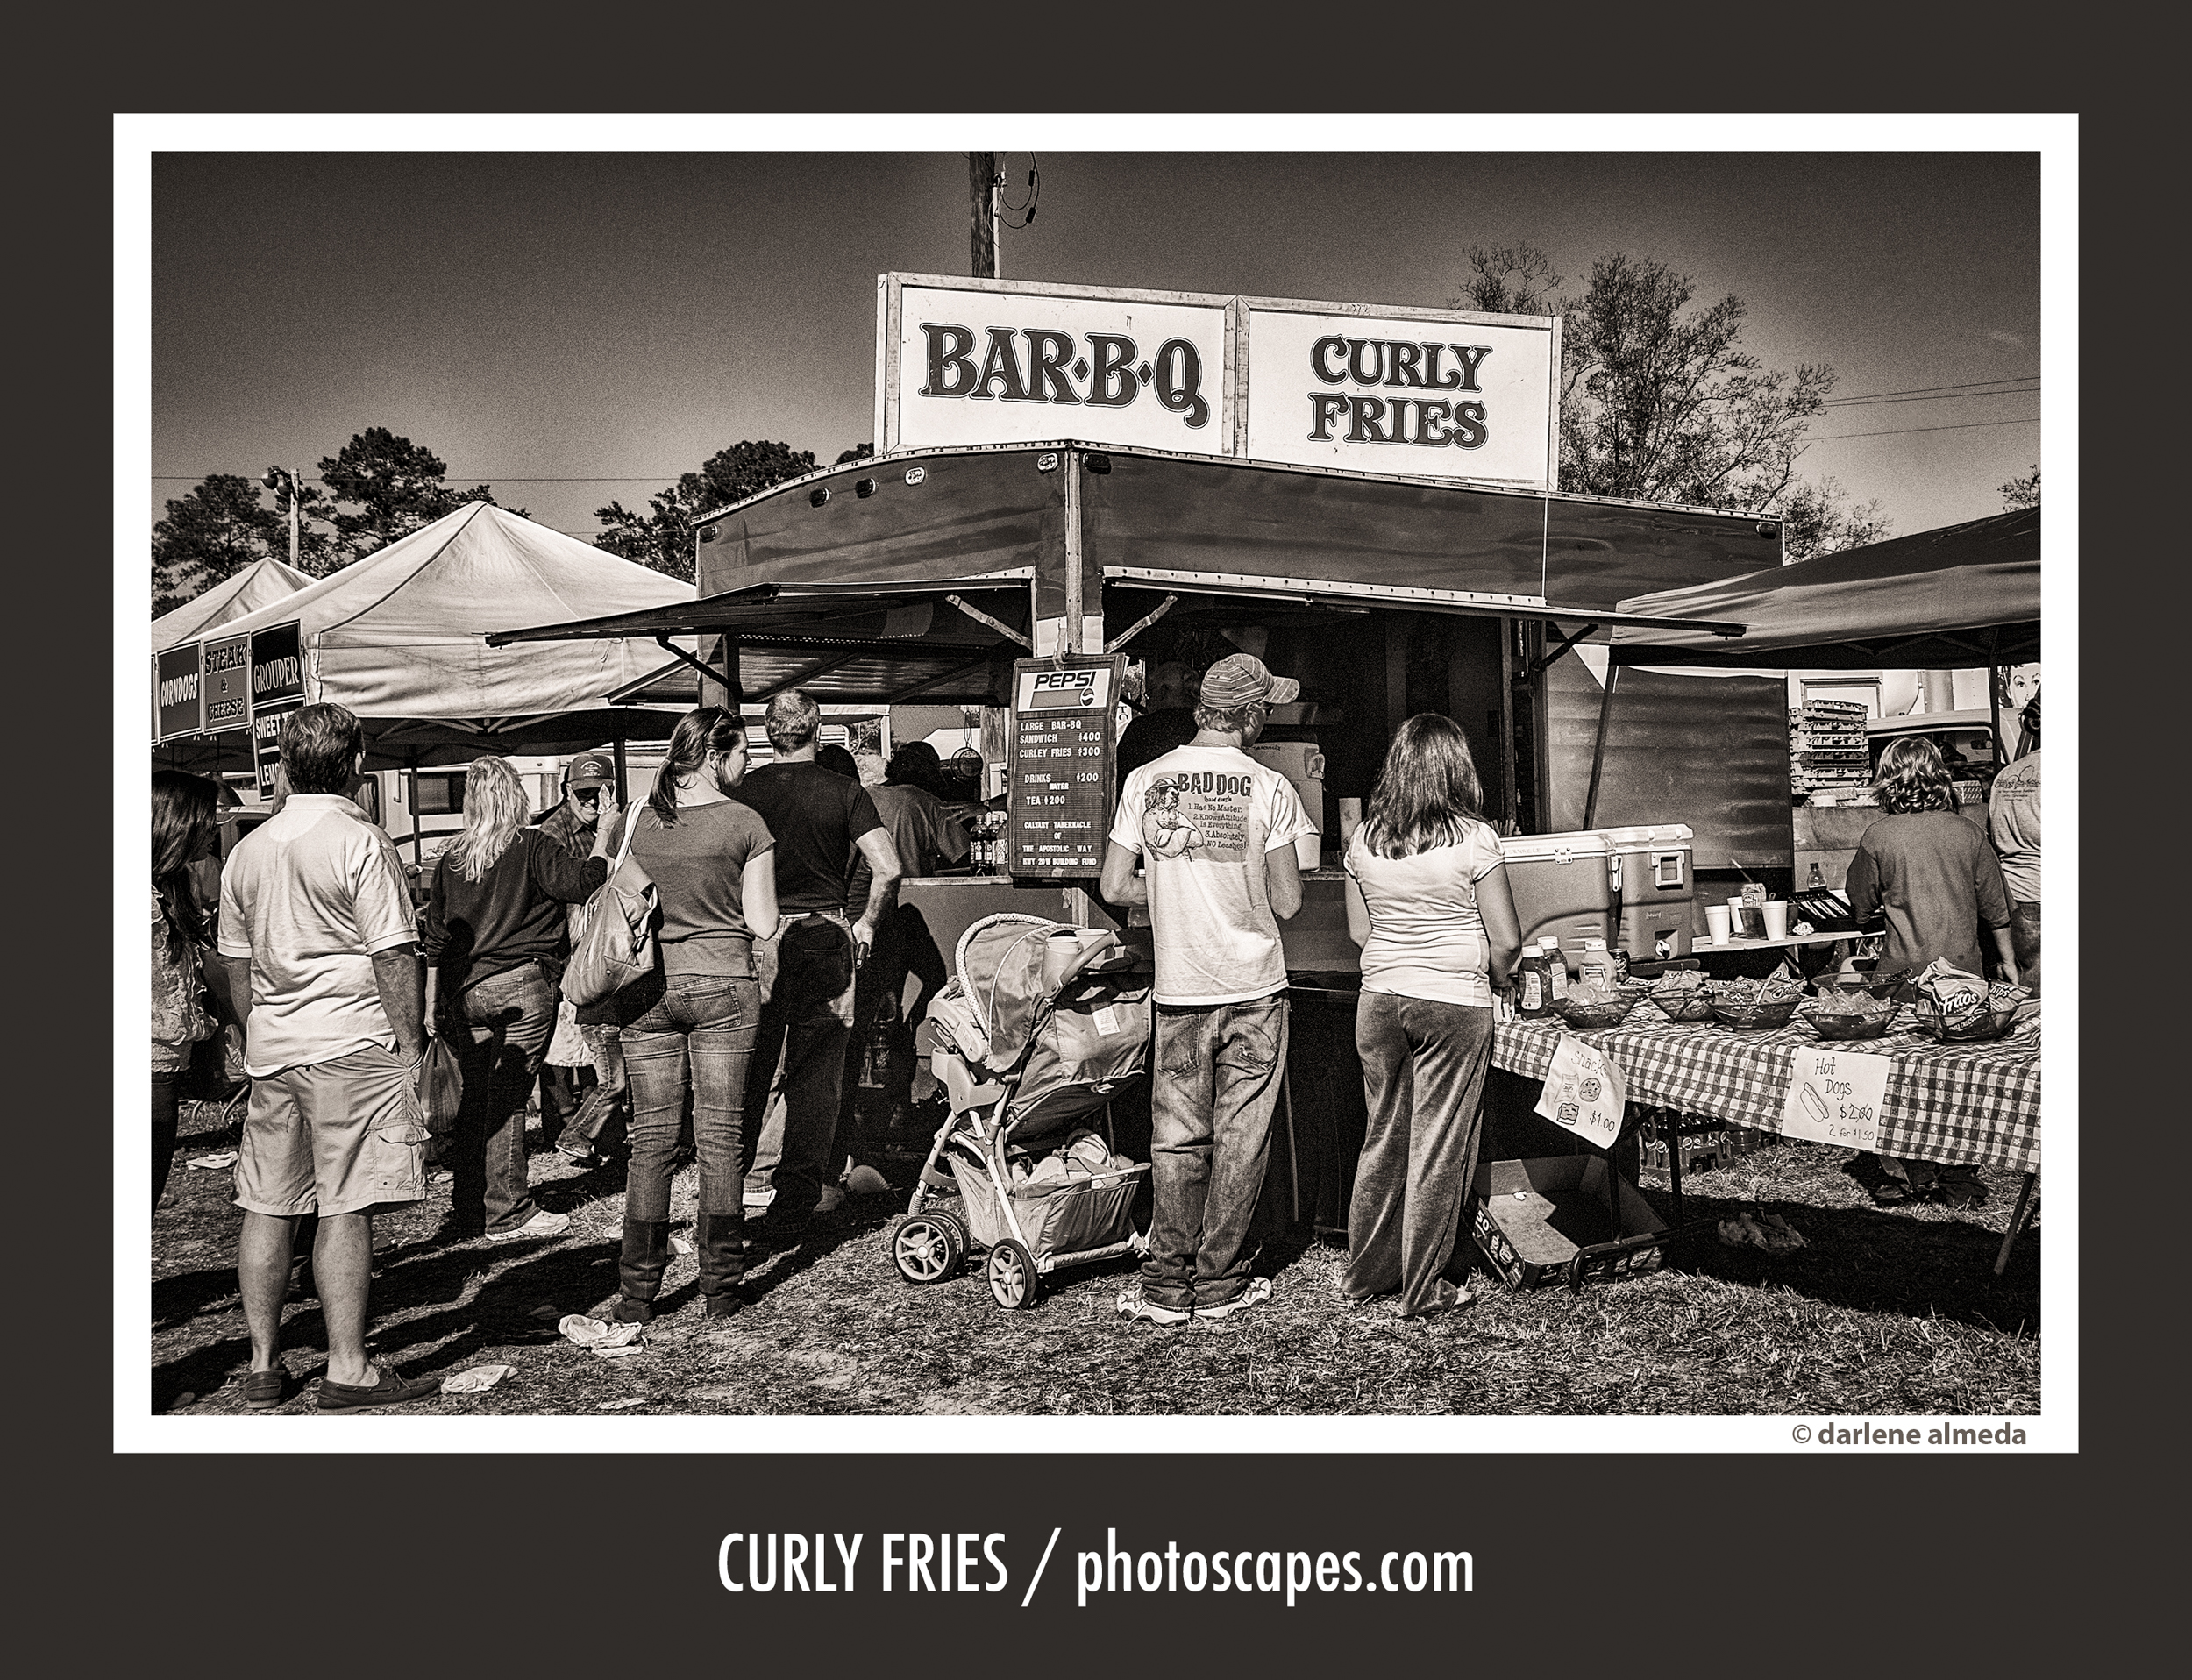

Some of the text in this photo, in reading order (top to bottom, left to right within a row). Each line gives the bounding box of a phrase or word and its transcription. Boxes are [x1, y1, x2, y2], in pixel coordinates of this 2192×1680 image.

[1310, 334, 1494, 393] CURLY
[1308, 391, 1489, 452] FRIES
[205, 642, 247, 676] STEAK
[253, 656, 300, 694] GROUPER
[1034, 671, 1097, 689] PEPSI
[160, 672, 199, 708] CORNDOGS
[208, 696, 246, 723] CHEESE
[255, 713, 281, 740] SWEET
[1020, 719, 1082, 732] LARGE BAR-BQ
[1019, 733, 1057, 744] SANDWICH
[1019, 748, 1048, 758] CURLEY
[1050, 747, 1072, 758] FRIES
[1024, 772, 1052, 784] DRINKS
[1048, 782, 1070, 791] WATER
[1178, 772, 1253, 797] BAD DOG
[1025, 795, 1042, 806] TEA
[1989, 983, 2011, 999] hips
[1570, 1050, 1608, 1079] Snacks
[1814, 1057, 1836, 1075] Hot
[1824, 1078, 1853, 1101] Dogs
[1589, 1109, 1616, 1132] $1.00
[1828, 1123, 1836, 1137] 2
[1839, 1128, 1851, 1138] for
